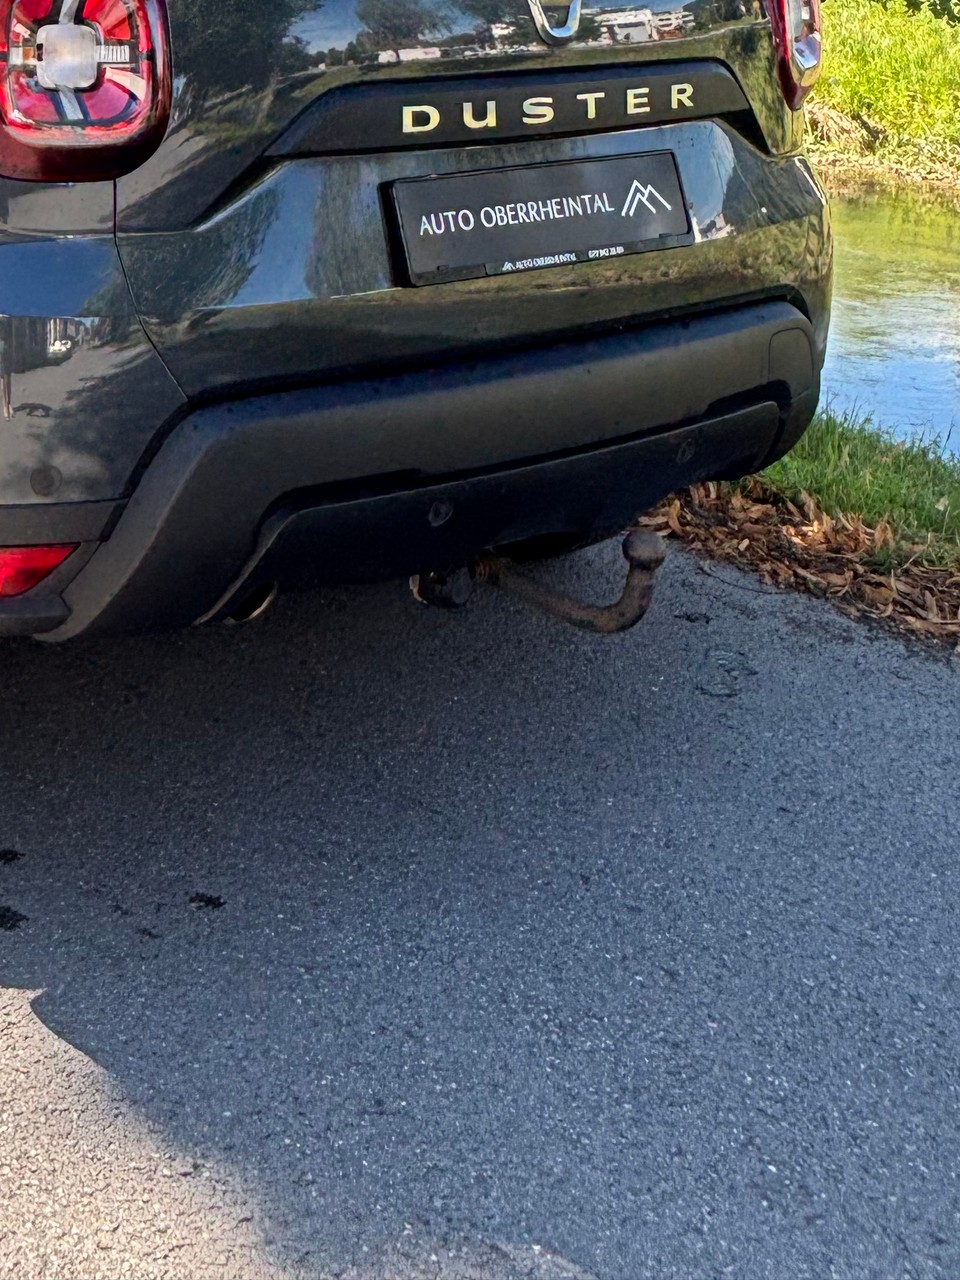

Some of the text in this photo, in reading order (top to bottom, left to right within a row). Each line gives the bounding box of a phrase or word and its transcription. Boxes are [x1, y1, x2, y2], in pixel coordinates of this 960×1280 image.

[401, 82, 695, 134] DUSTER
[419, 192, 615, 236] AUTO OBERRHEINTAL
